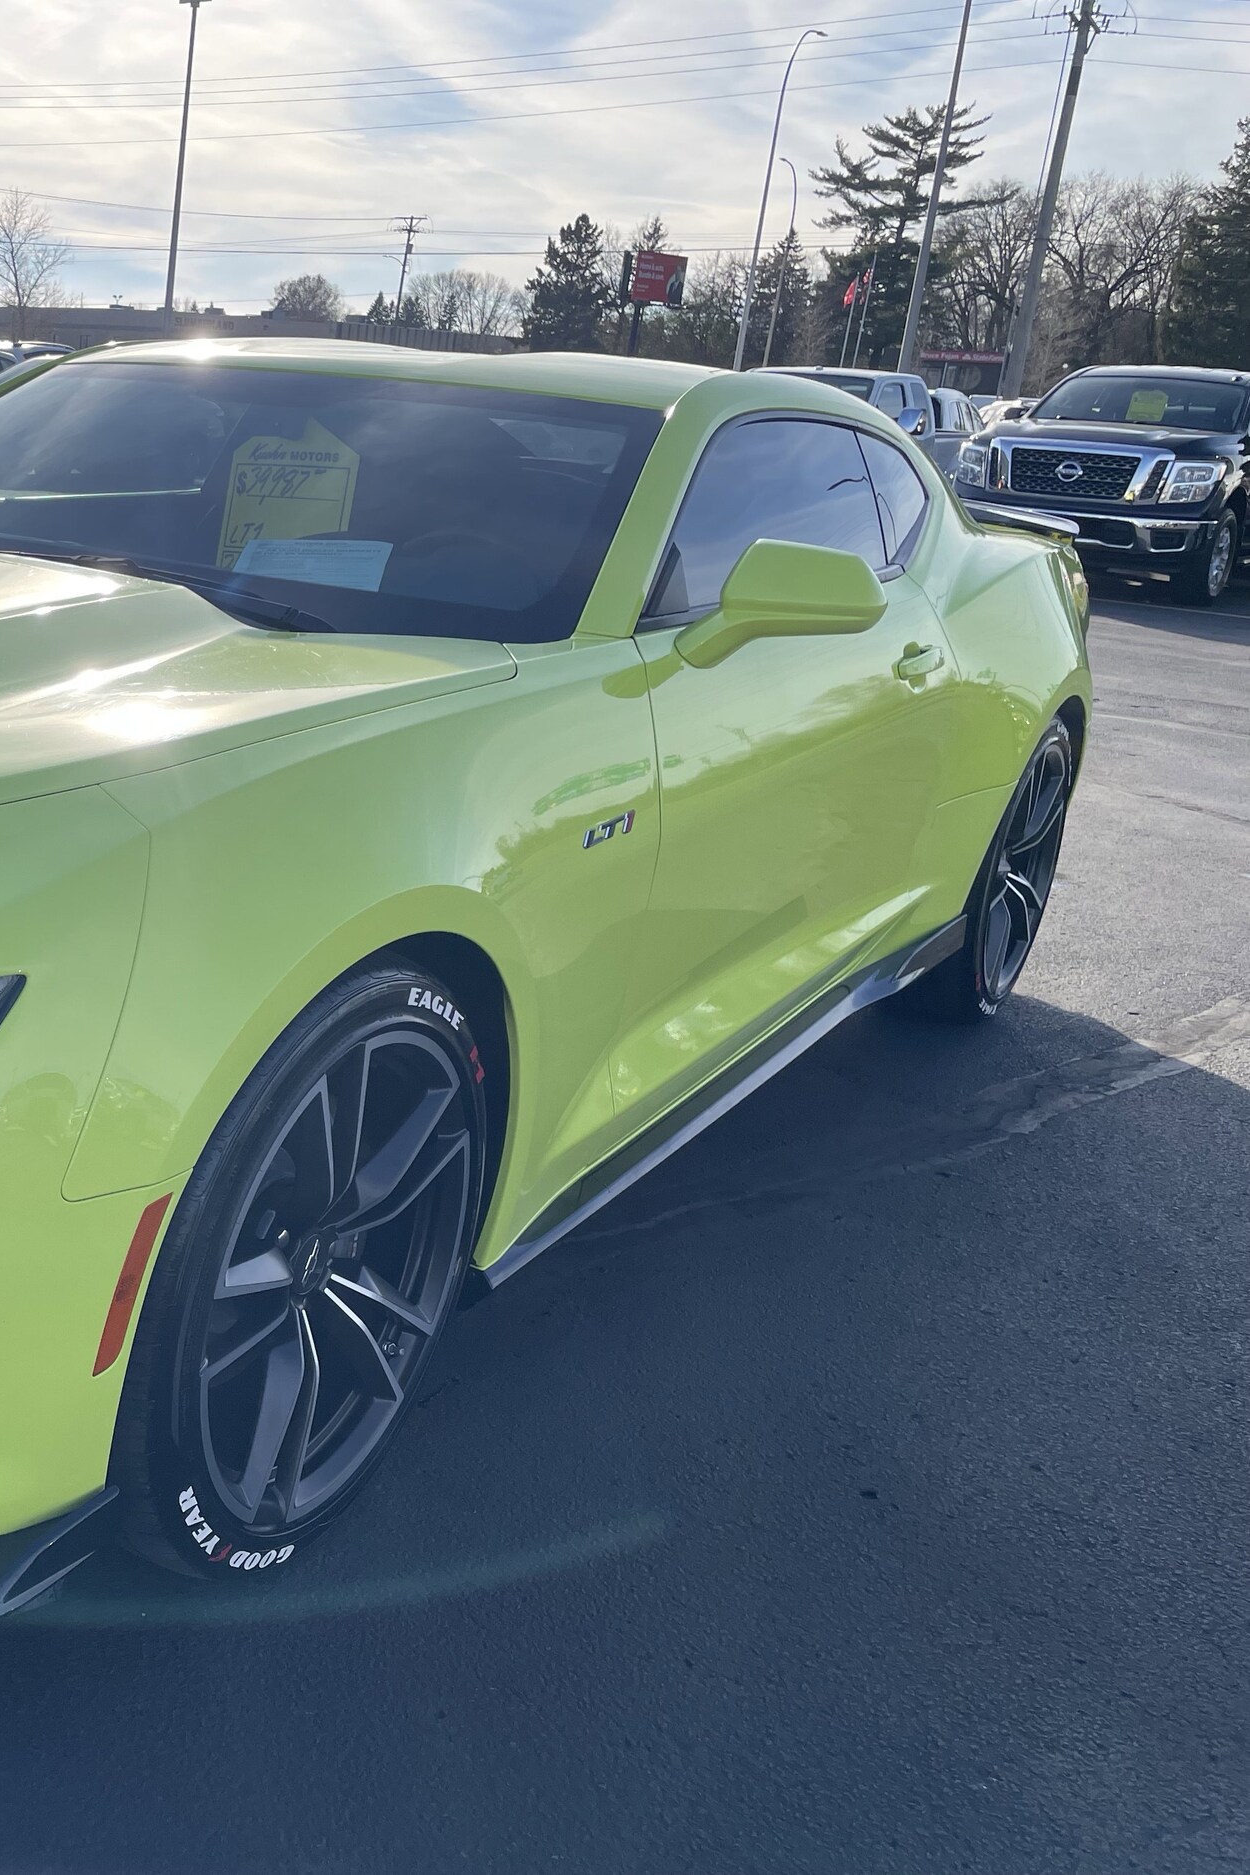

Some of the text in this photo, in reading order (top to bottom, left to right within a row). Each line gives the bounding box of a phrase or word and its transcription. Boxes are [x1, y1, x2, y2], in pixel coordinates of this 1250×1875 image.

[290, 451, 340, 462] MOTORS
[583, 809, 636, 850] LT1
[407, 987, 465, 1031] EAGLE
